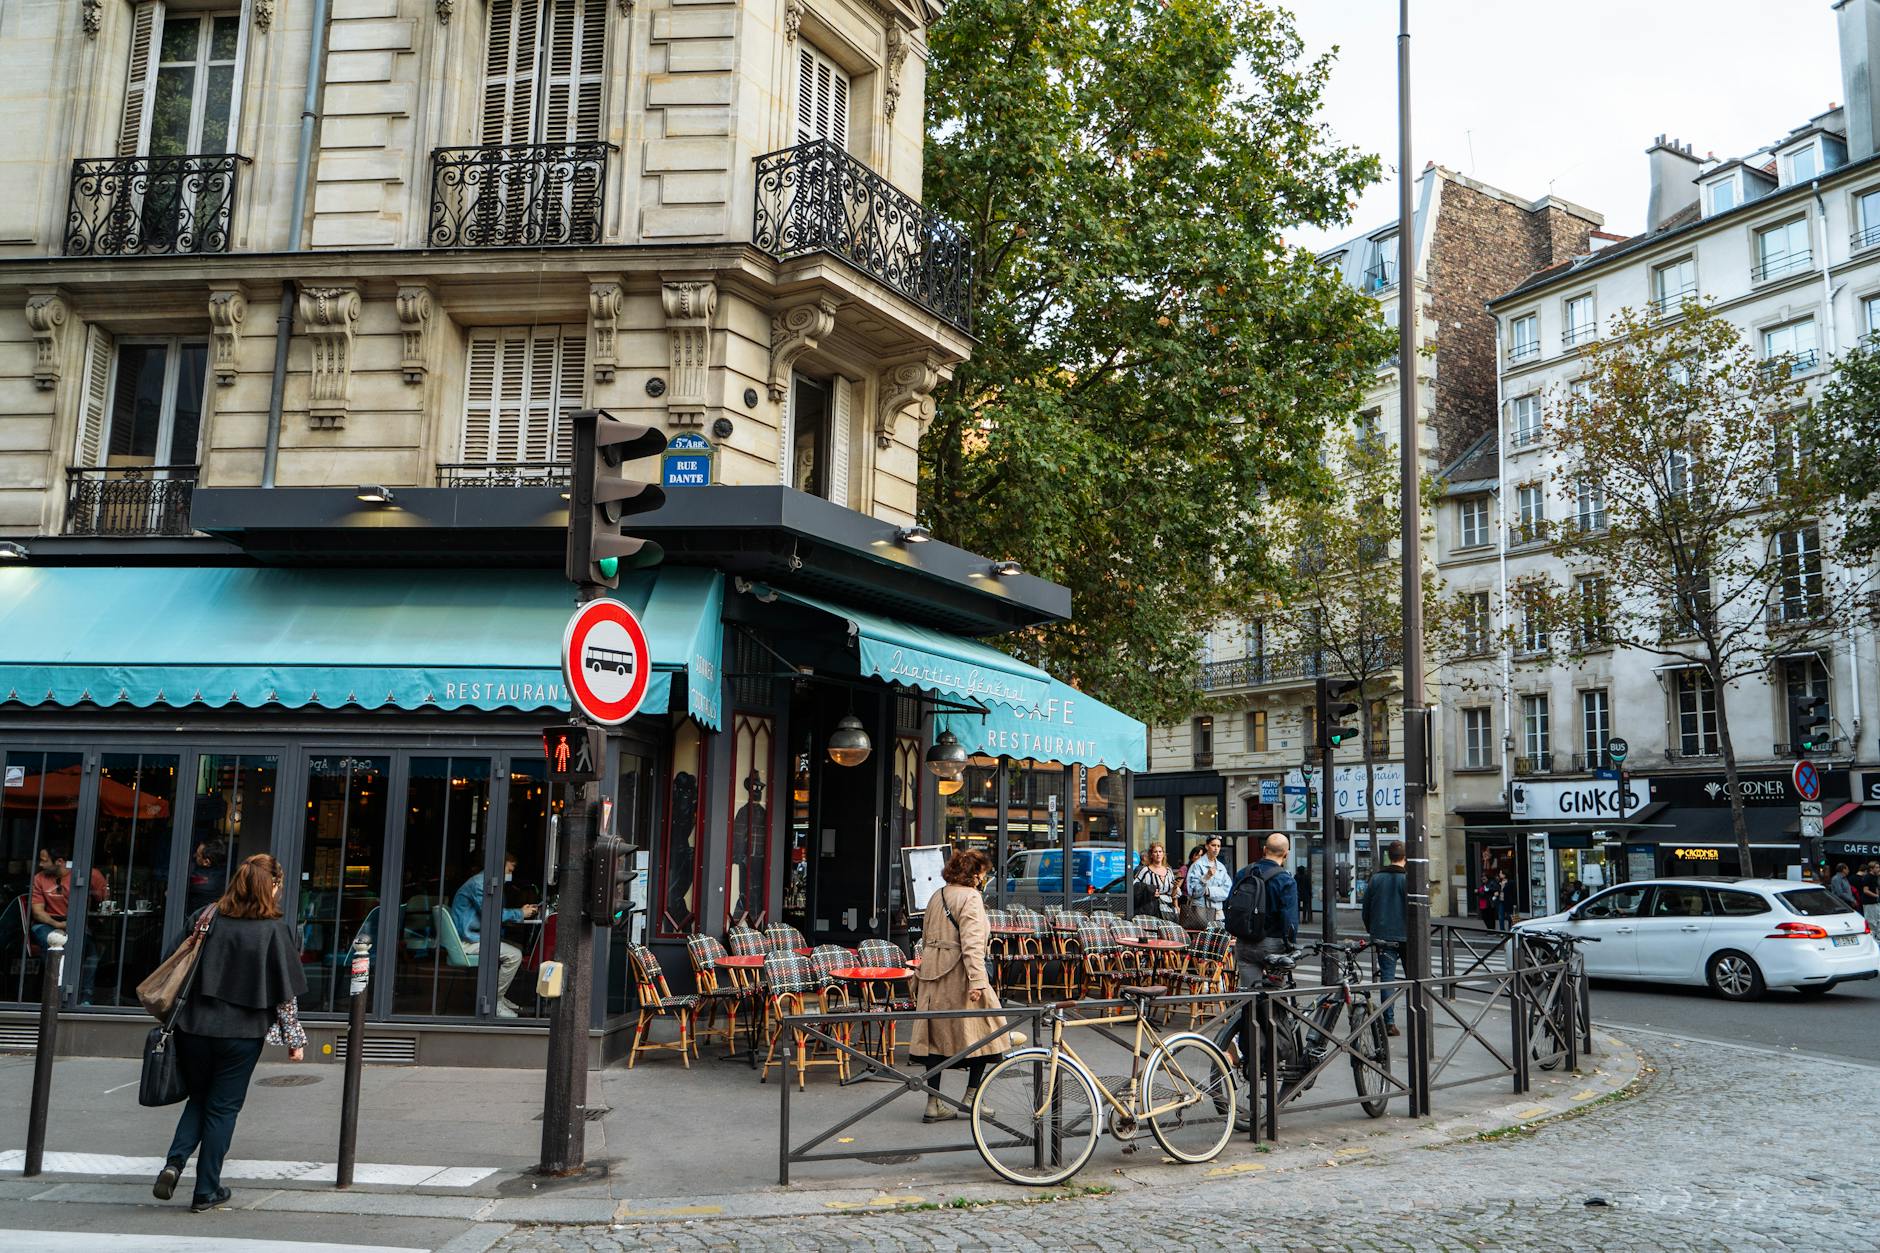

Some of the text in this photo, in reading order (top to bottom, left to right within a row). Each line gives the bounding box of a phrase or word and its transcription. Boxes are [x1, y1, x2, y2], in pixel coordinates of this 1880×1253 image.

[677, 461, 698, 470] RUE
[669, 474, 704, 483] DANTE
[890, 650, 965, 690] Quartier
[988, 729, 1097, 757] RESTAURANT
[1610, 743, 1626, 751] BUS
[1844, 843, 1869, 853] CAFE
